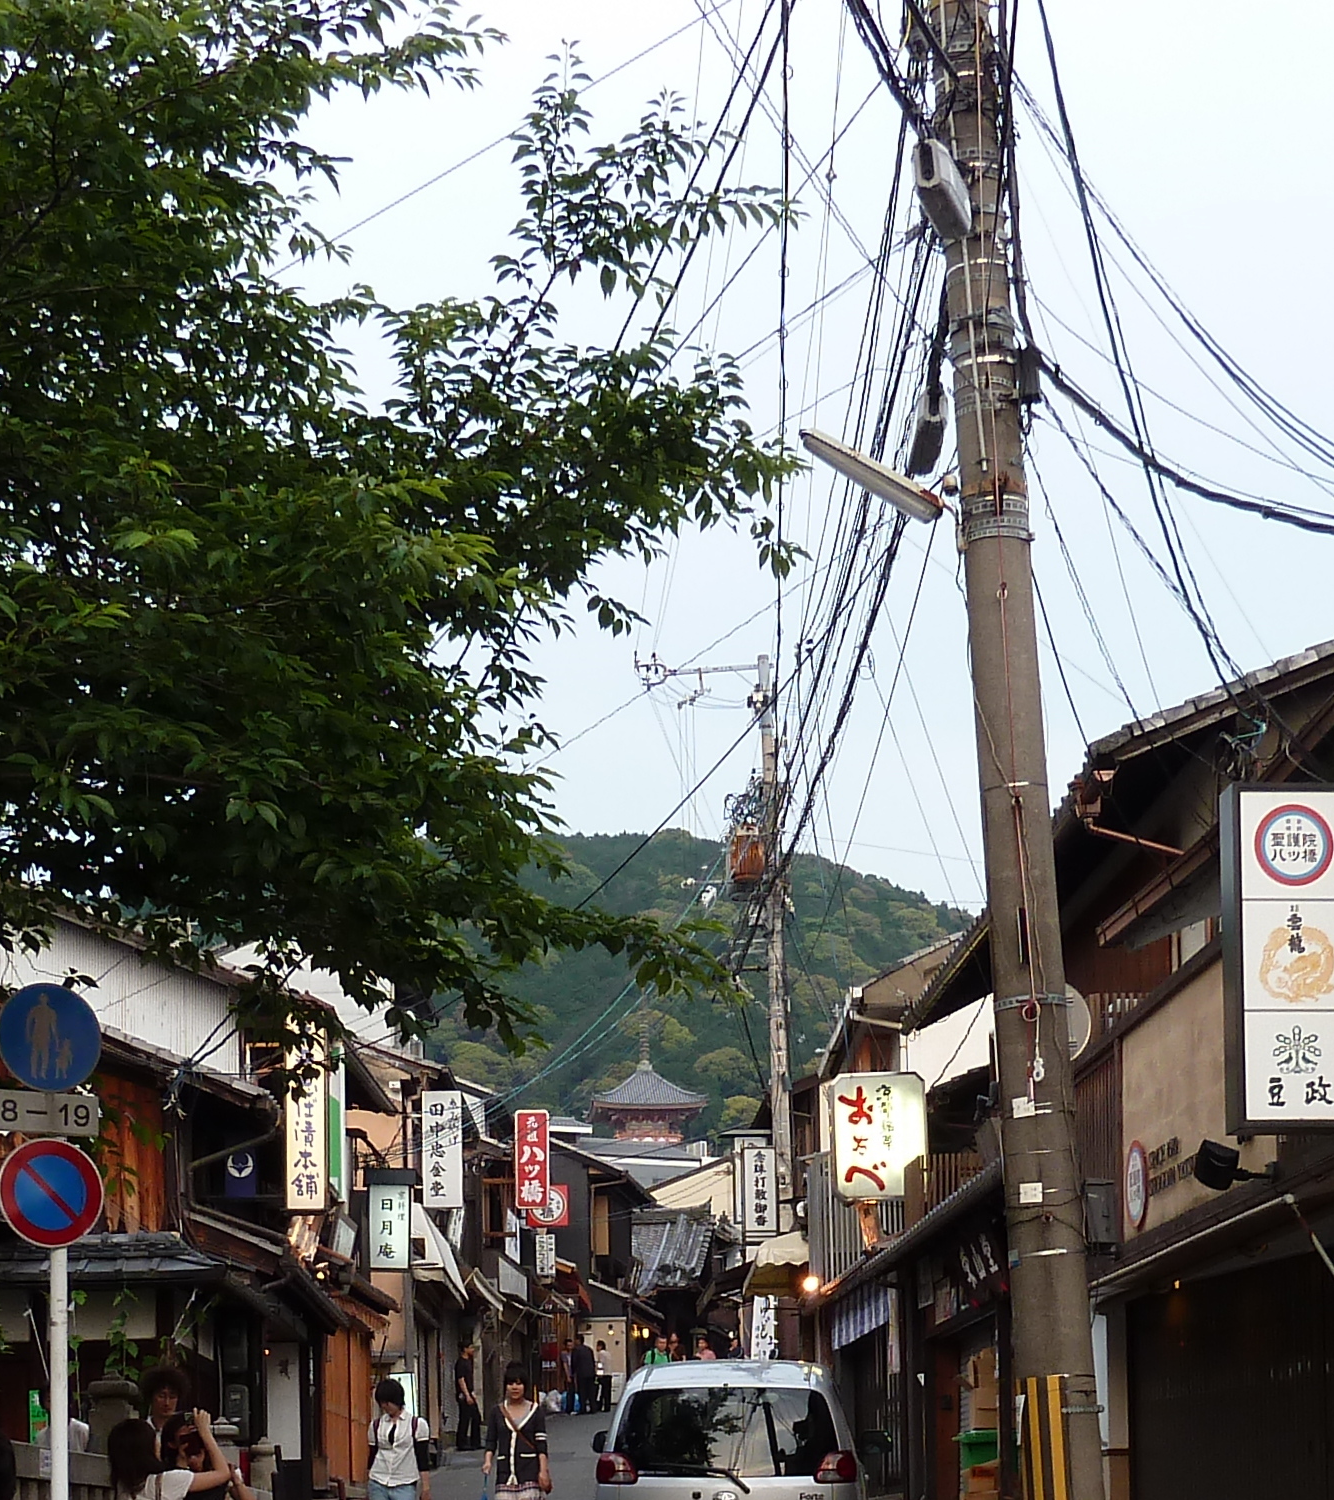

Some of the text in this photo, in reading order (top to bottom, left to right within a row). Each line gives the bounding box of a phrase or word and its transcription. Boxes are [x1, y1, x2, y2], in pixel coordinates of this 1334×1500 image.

[1267, 1076, 1334, 1107] 豆政
[377, 1198, 397, 1259] 日月庵
